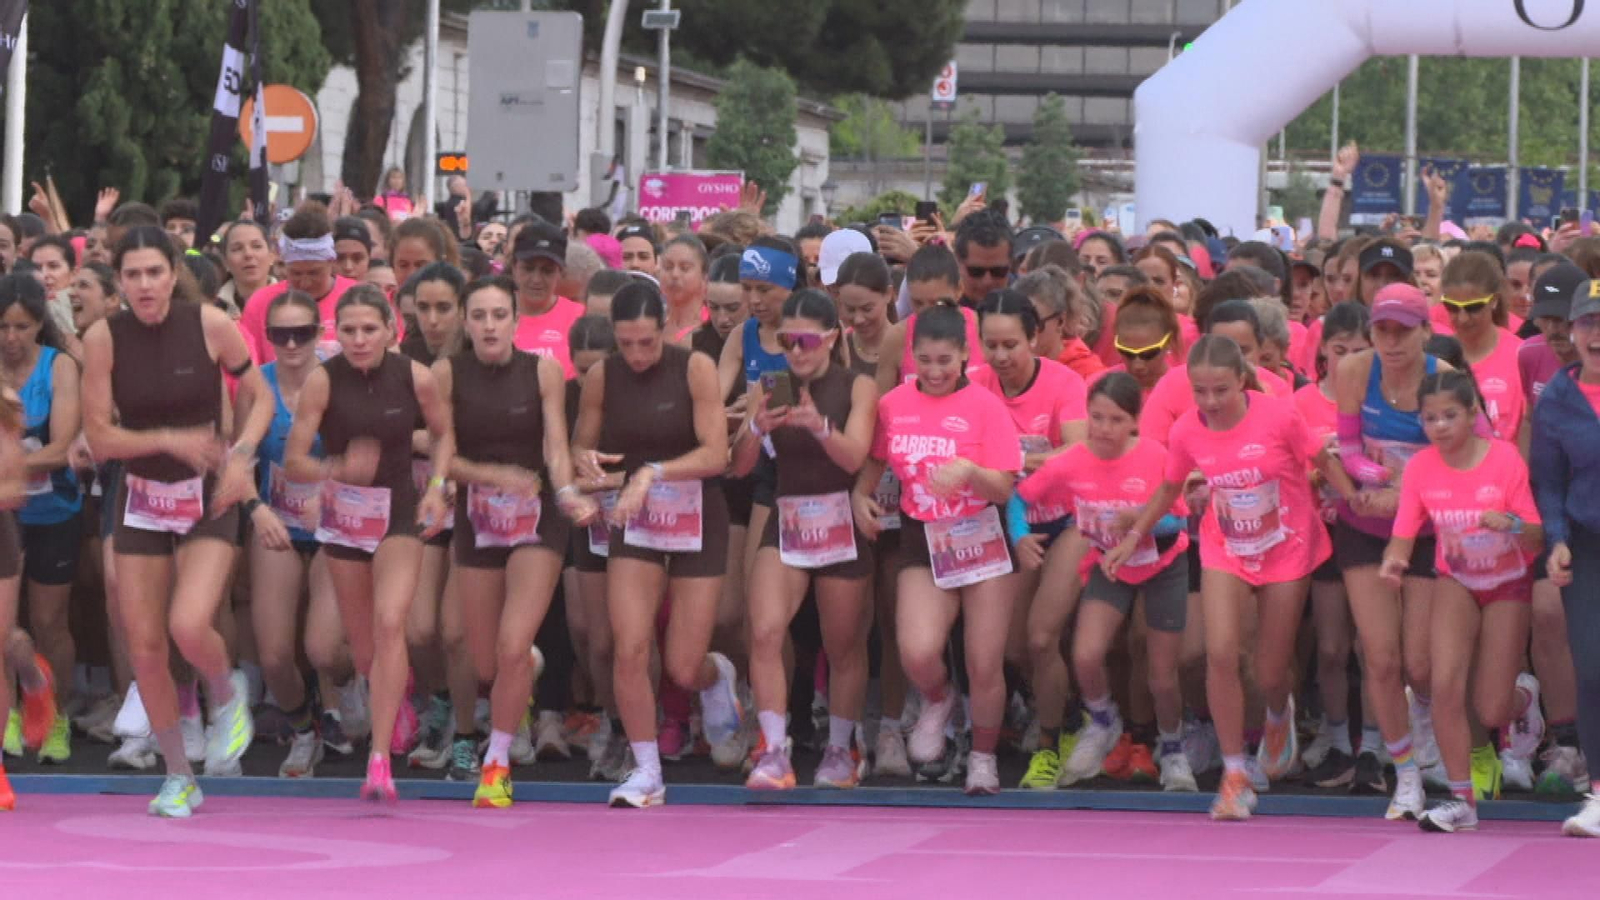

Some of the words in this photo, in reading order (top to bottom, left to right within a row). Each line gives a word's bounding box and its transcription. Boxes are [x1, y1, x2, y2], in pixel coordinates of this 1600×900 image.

[698, 183, 739, 194] OYSHO
[892, 434, 956, 456] CARRERA
[649, 509, 677, 527] 016
[1234, 517, 1262, 533] 016
[801, 526, 829, 543] 016
[956, 545, 983, 561] 016
